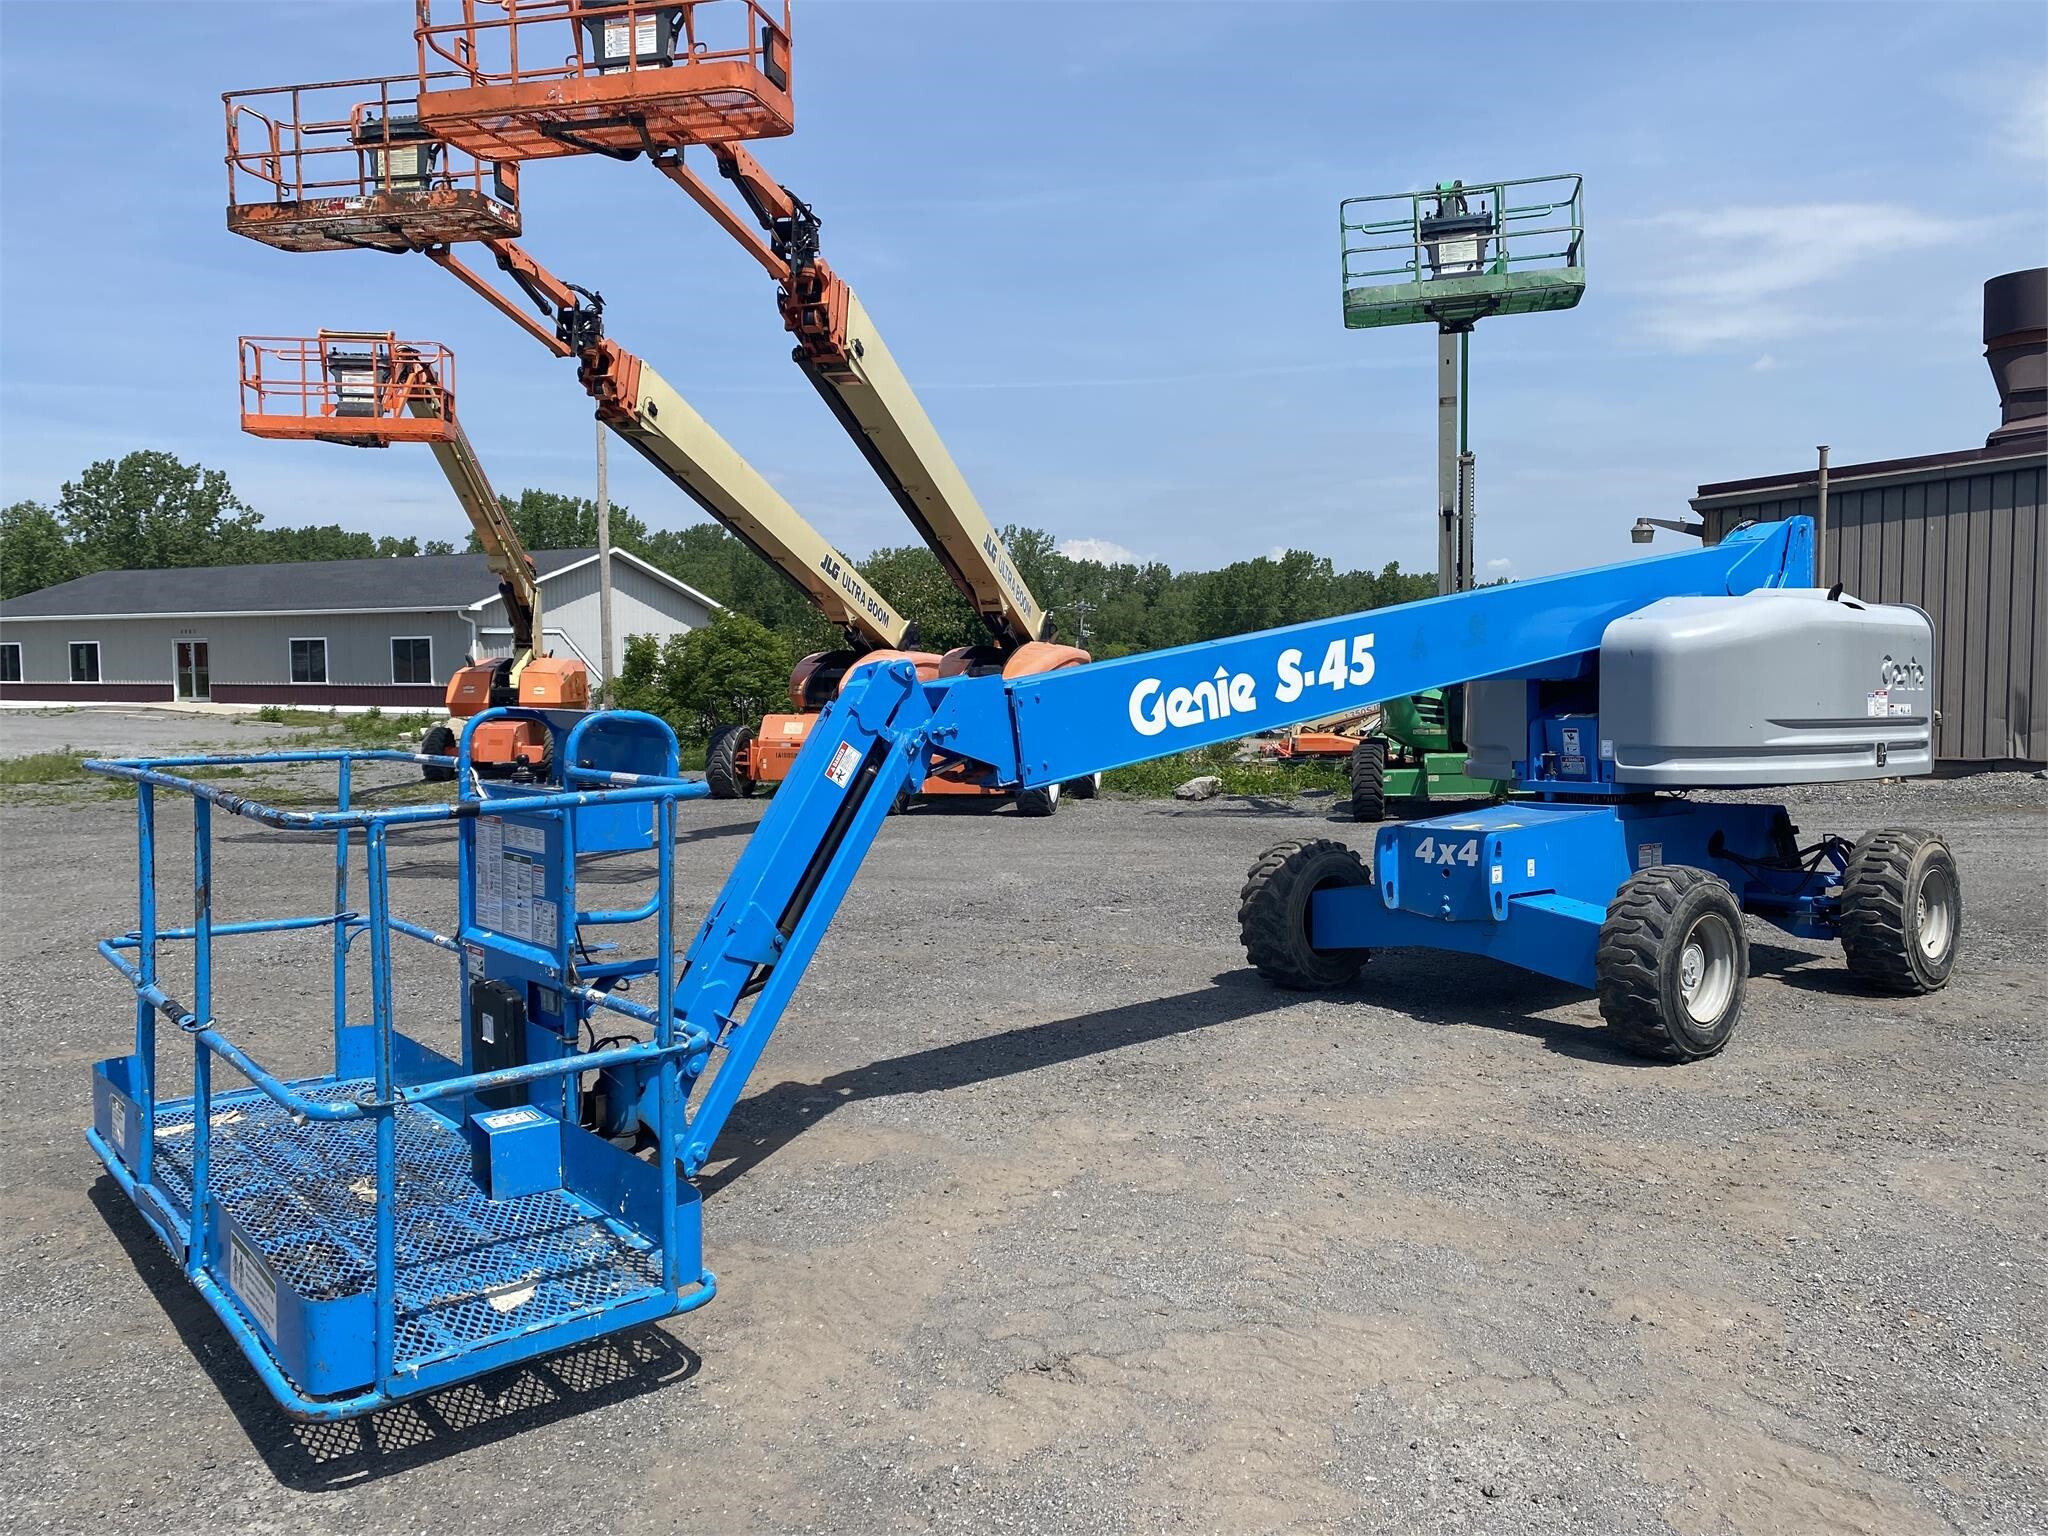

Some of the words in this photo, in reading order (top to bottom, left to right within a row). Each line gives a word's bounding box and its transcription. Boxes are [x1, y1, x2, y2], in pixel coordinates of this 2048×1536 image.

[819, 553, 841, 581] JLG
[842, 571, 867, 608] ULTRA
[867, 596, 890, 629] BOOM
[983, 533, 998, 564] JLG
[999, 553, 1016, 594] ULTRA
[1015, 584, 1032, 620] BOOM
[1128, 665, 1257, 736] Genie
[1275, 633, 1376, 703] S-45
[1415, 836, 1479, 867] 4x4
